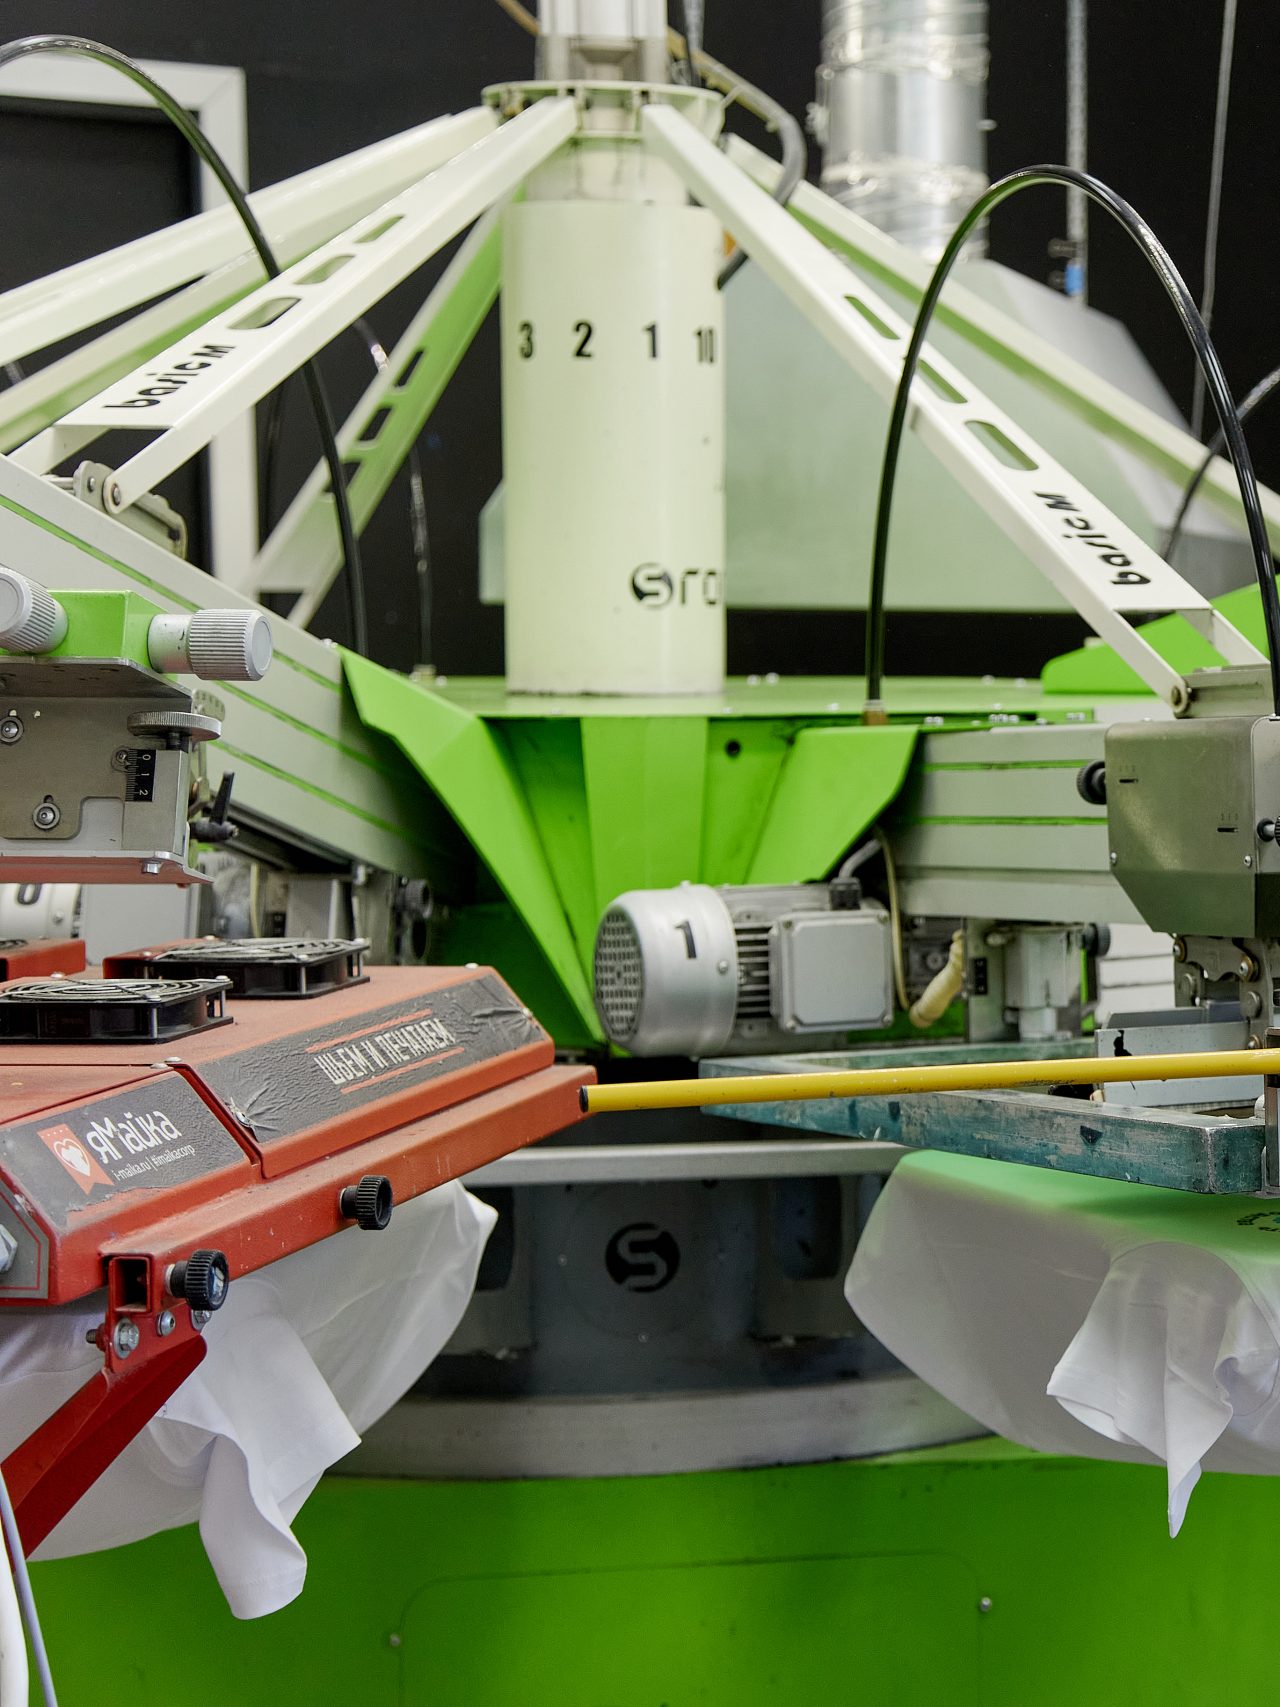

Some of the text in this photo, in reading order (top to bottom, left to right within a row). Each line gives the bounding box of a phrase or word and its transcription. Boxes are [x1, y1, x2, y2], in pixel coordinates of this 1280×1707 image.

[519, 322, 534, 359] 3
[573, 321, 592, 358] 2
[645, 323, 657, 359] 1
[674, 920, 698, 960] 1
[359, 1040, 389, 1069] И
[374, 1017, 456, 1065] ПЕЧАТАЕМ
